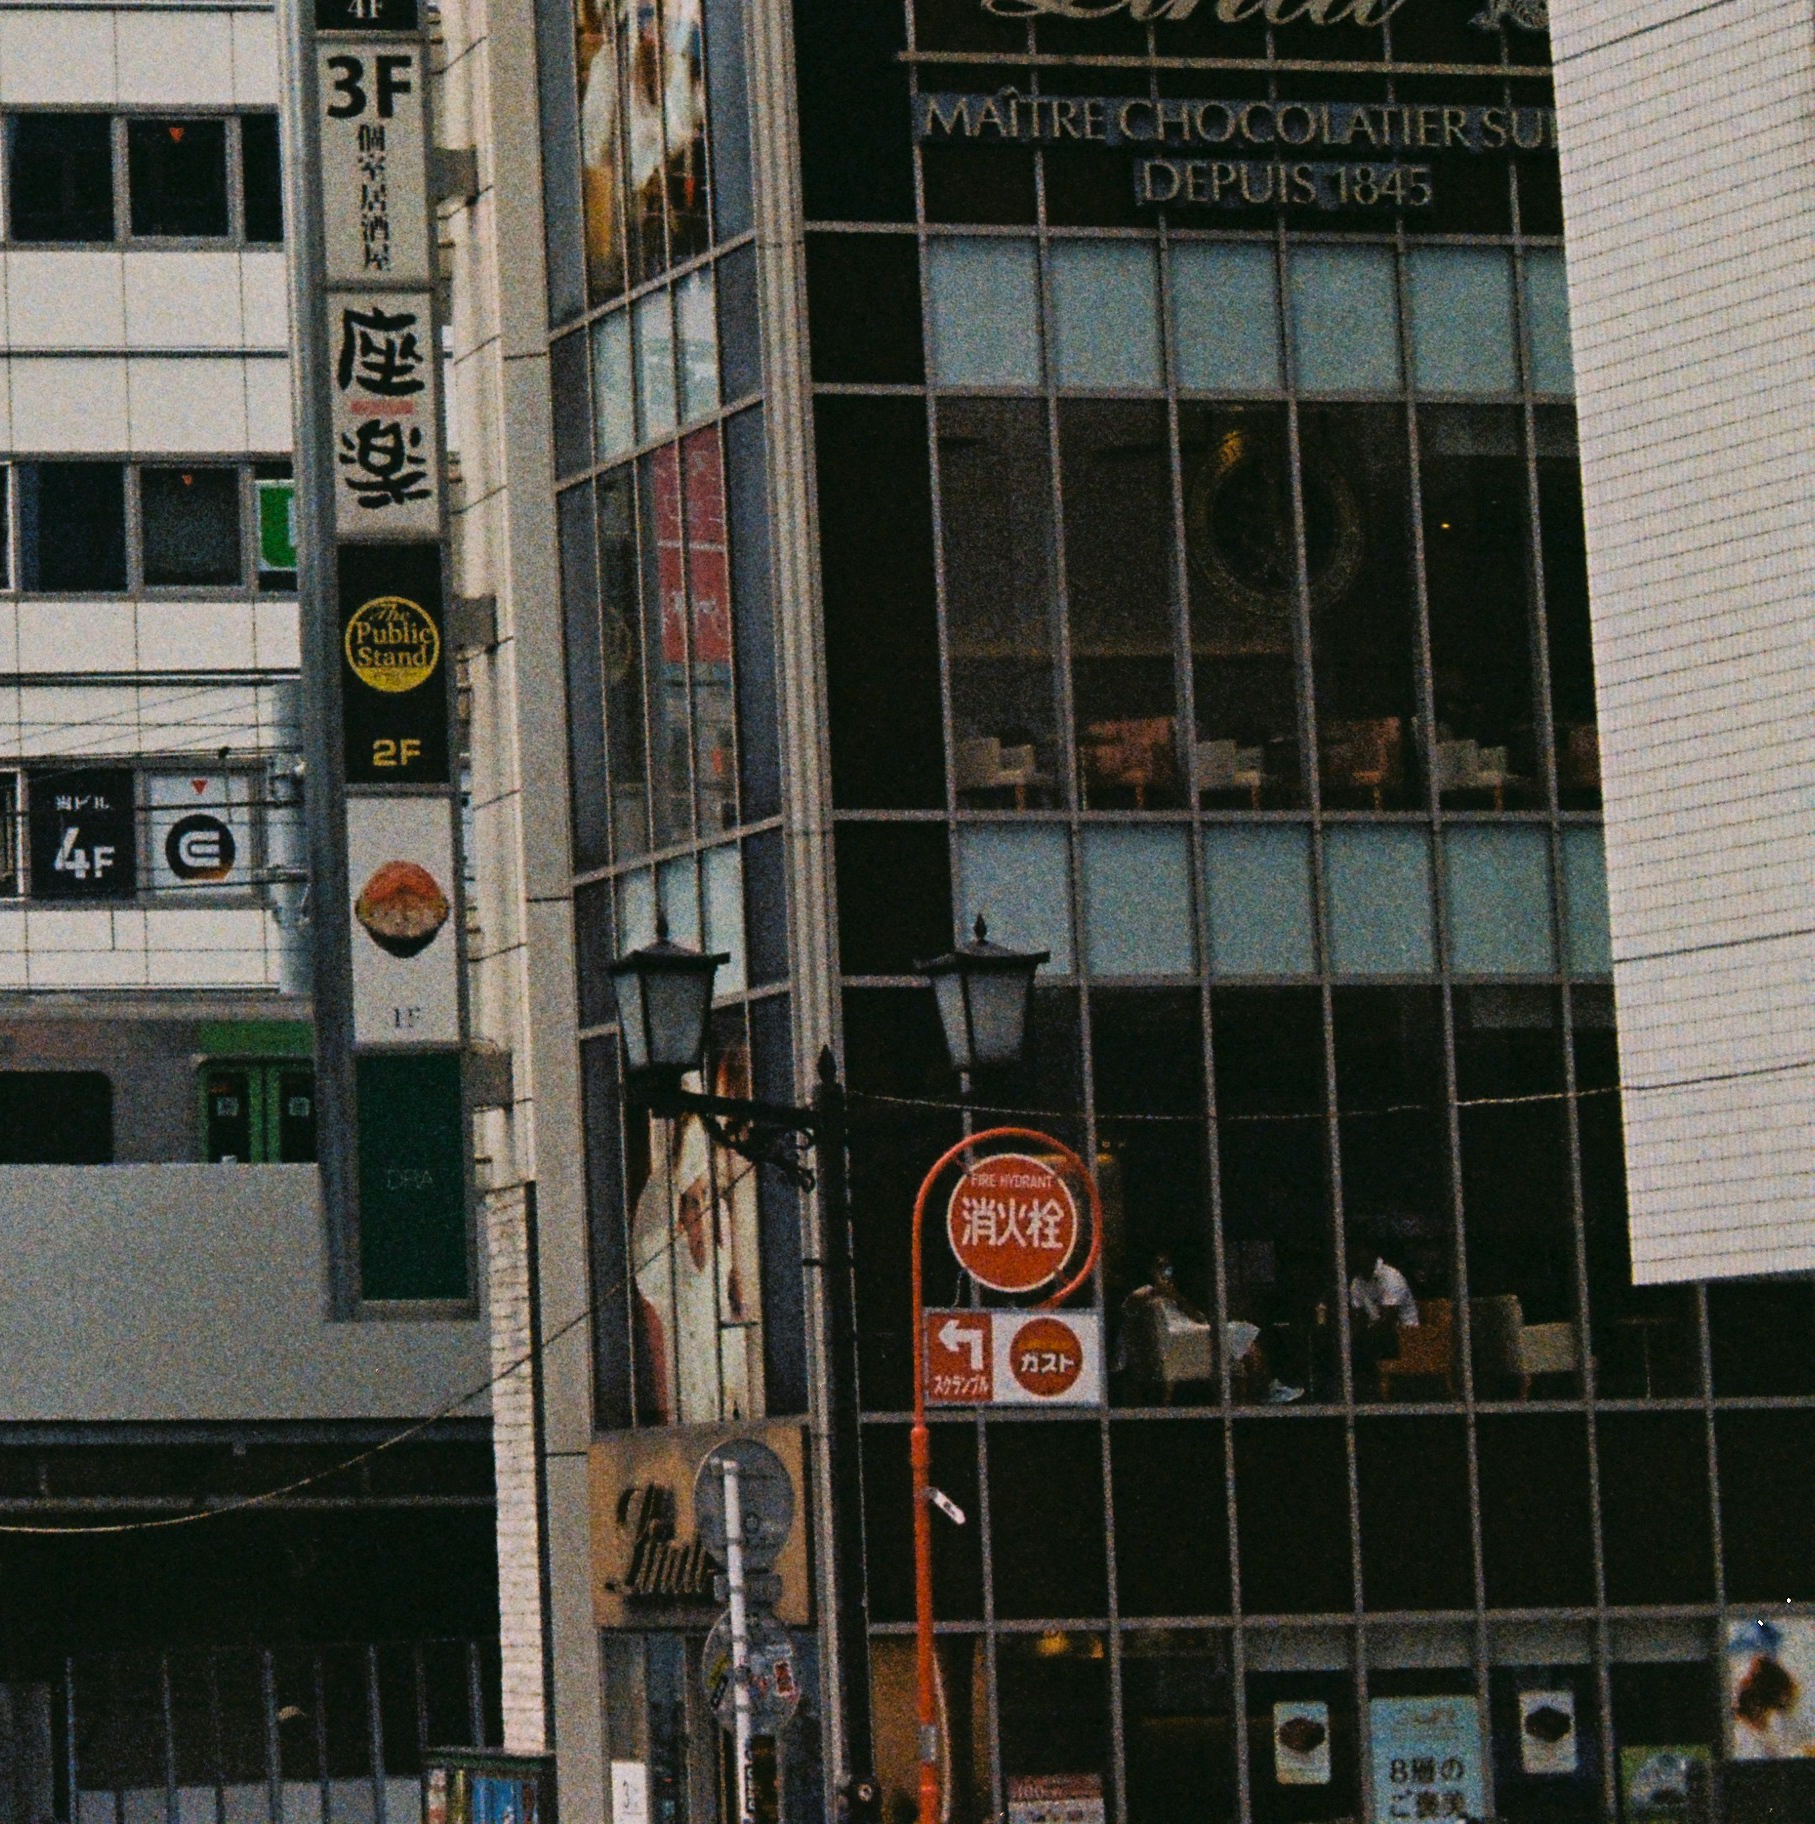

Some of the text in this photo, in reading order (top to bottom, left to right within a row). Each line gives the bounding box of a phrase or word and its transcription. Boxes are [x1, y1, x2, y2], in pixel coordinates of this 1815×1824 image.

[326, 55, 412, 119] 3F
[921, 83, 1561, 150] MAÎTRE CHOCOLATIER SU
[1140, 159, 1433, 207] DEPUIS 1845
[355, 620, 434, 645] Public
[357, 645, 428, 668] Stand
[371, 738, 422, 767] 2F
[53, 826, 117, 880] 4F
[970, 1174, 1053, 1190] FIRE HYDRANT
[961, 1196, 1066, 1250] 消火栓
[1021, 1350, 1075, 1374] ガスト
